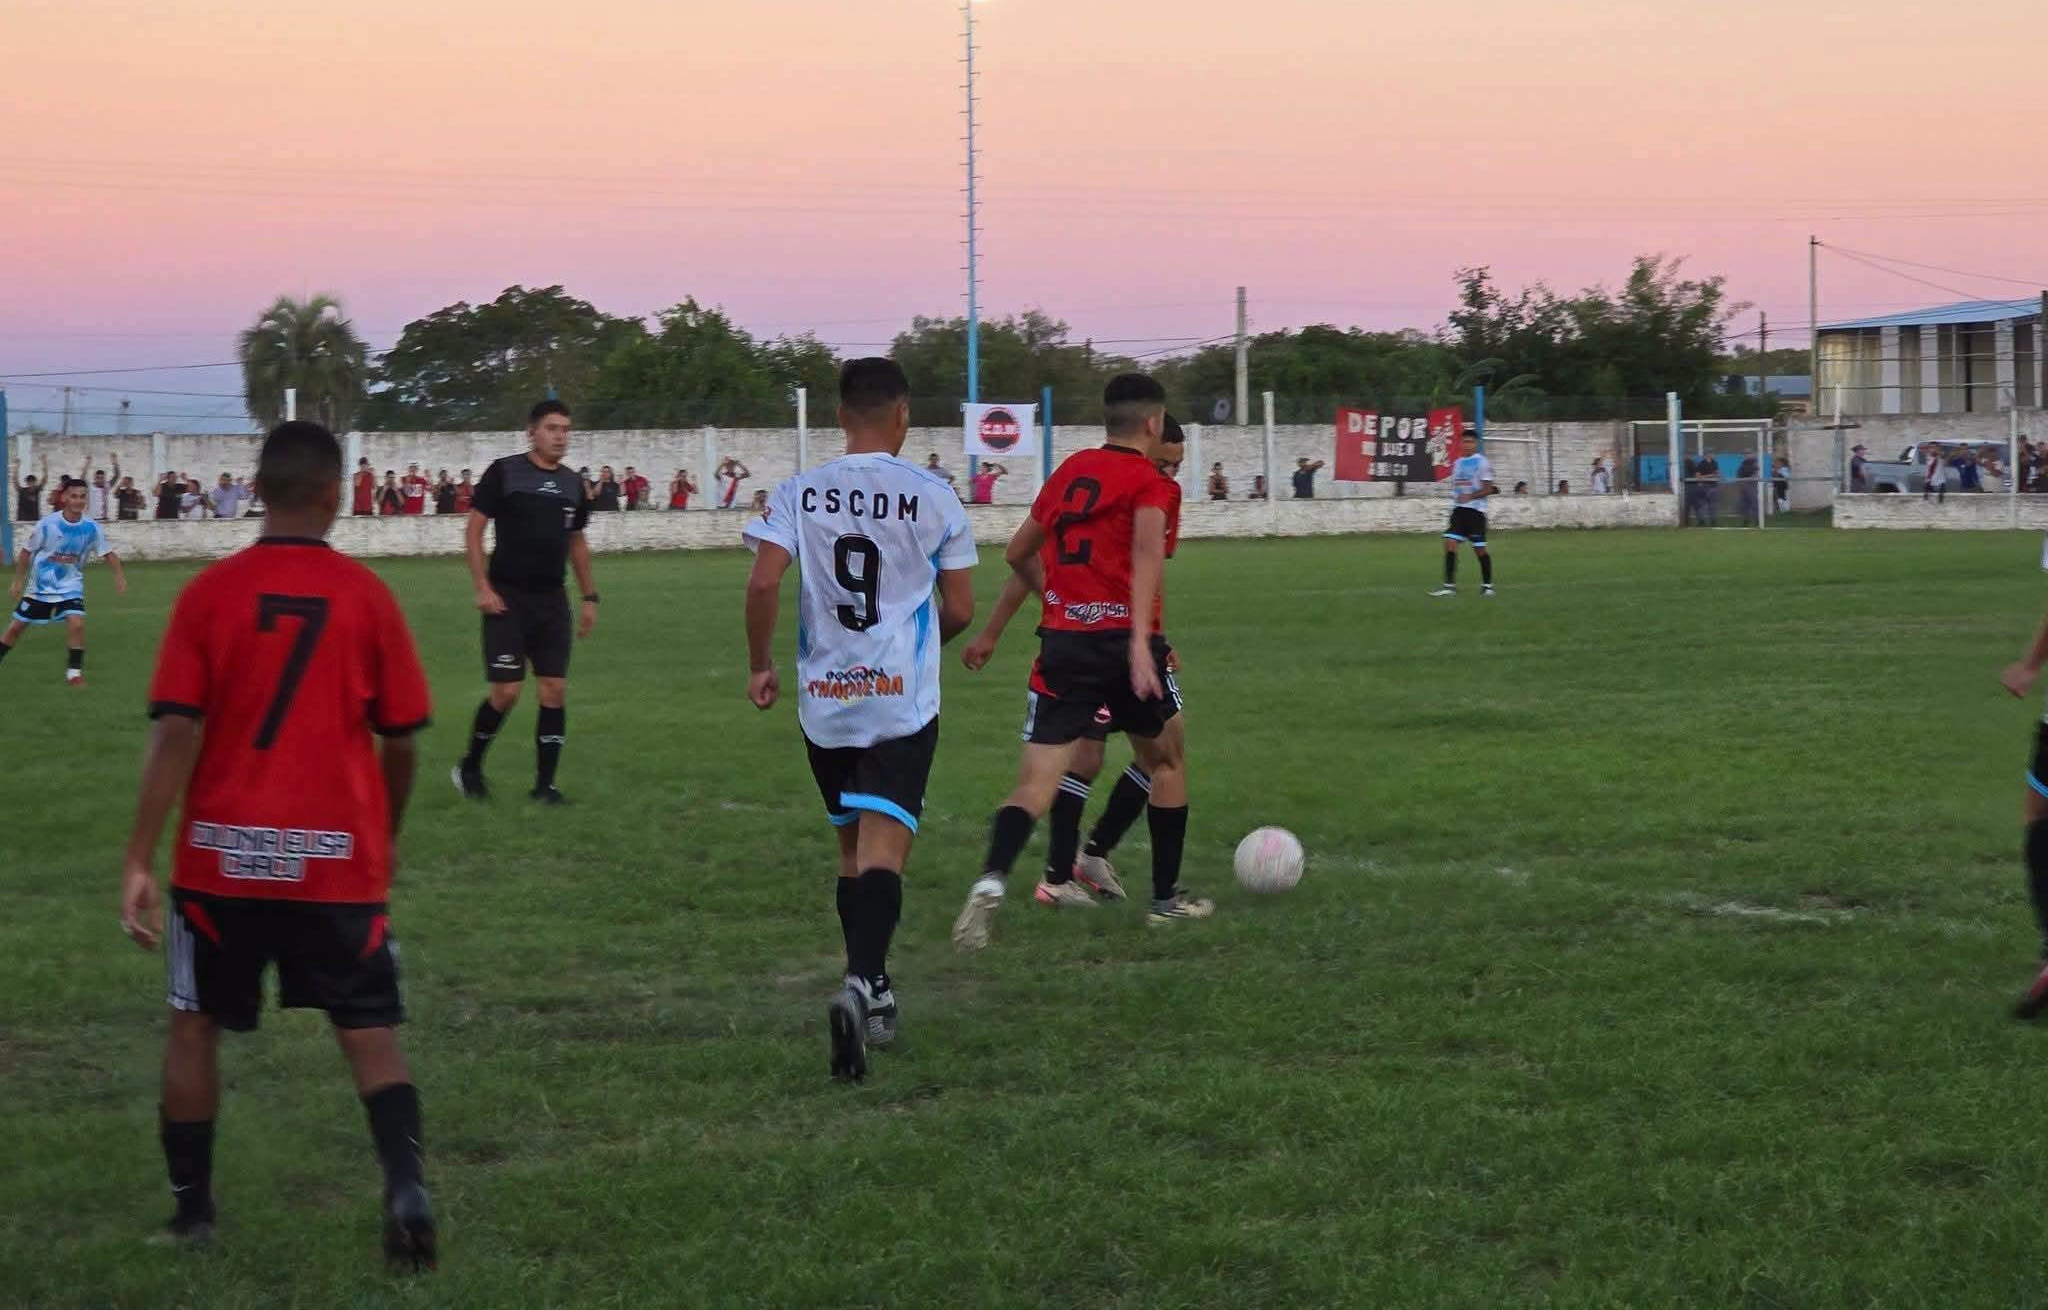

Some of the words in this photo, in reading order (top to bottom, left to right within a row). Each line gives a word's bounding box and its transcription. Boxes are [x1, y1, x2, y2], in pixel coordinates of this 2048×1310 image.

[1347, 411, 1428, 440] DEPOR
[802, 487, 919, 522] CSCDM
[1053, 476, 1102, 566] 2
[833, 533, 882, 632] 9
[254, 594, 330, 750] 7
